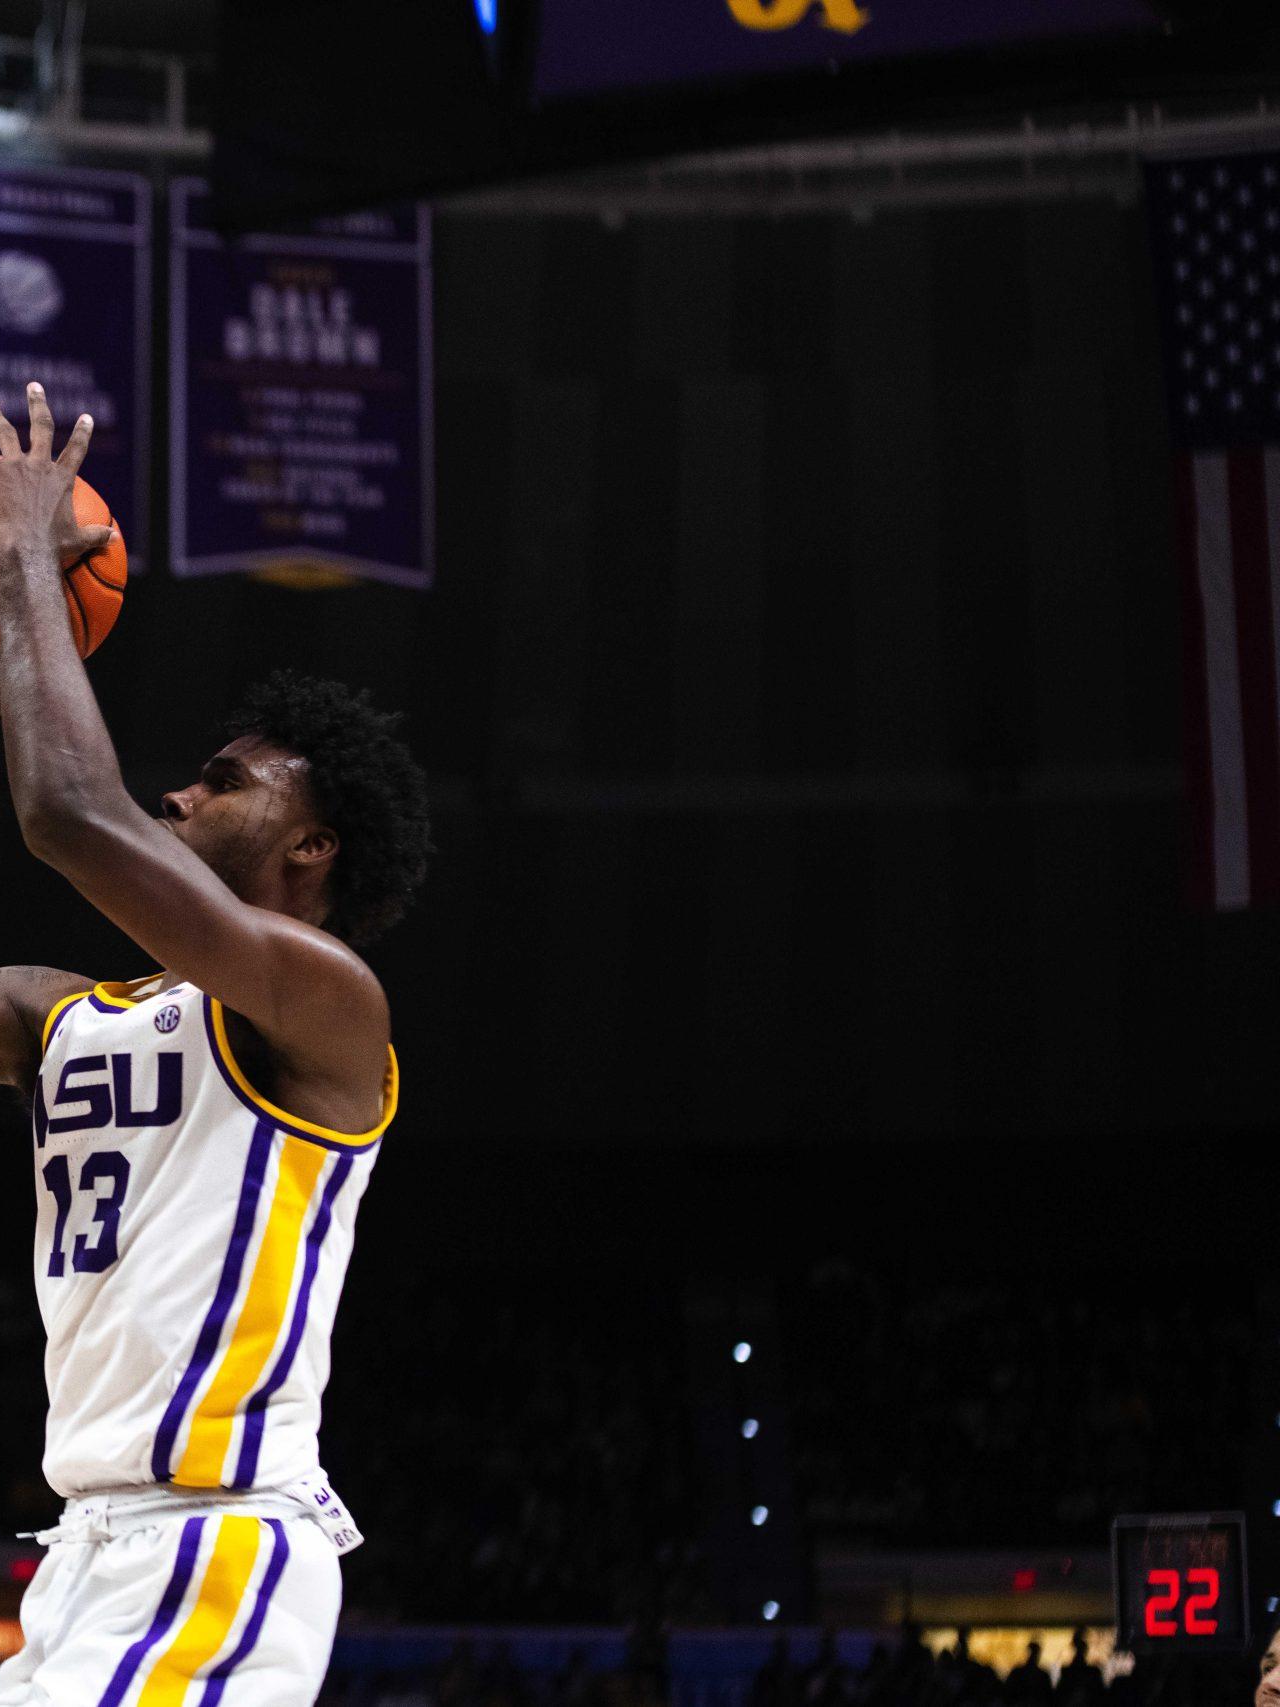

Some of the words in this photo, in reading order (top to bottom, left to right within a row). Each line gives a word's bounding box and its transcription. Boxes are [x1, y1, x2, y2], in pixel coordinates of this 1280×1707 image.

[155, 1006, 180, 1032] SEC
[42, 1151, 131, 1278] 13
[1145, 1568, 1219, 1637] 22
